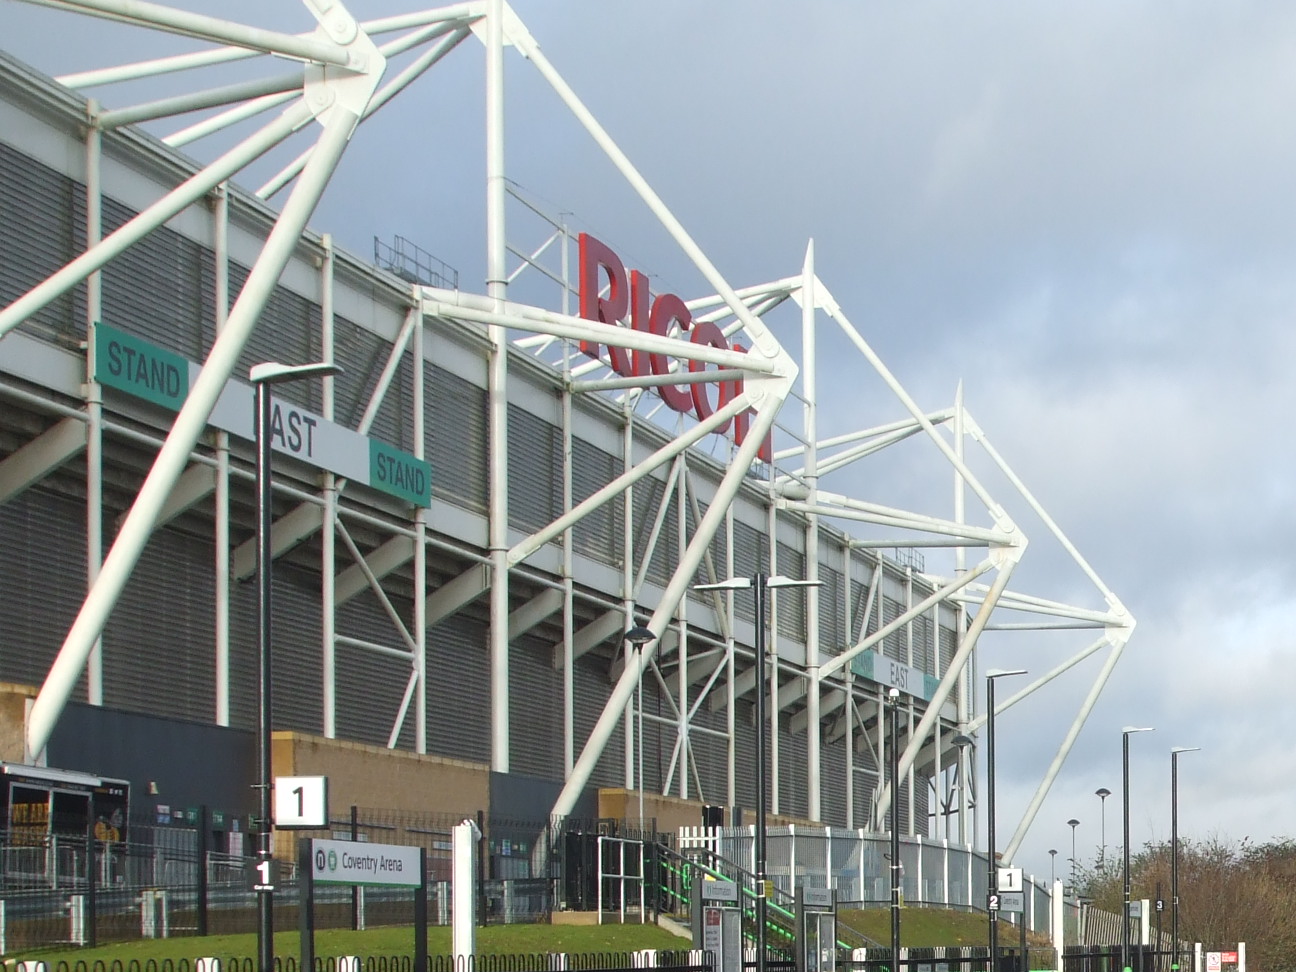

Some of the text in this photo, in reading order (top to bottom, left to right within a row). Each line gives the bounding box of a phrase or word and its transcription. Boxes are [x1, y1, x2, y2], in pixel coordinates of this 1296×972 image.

[107, 340, 425, 496] STAND AST STAND
[890, 662, 909, 690] EAST
[292, 786, 304, 817] 1
[256, 860, 269, 885] 1
[342, 852, 377, 874] Coventry
[379, 854, 403, 872] Arena
[1006, 872, 1013, 887] 1
[989, 895, 999, 907] 2
[1156, 900, 1163, 909] 3
